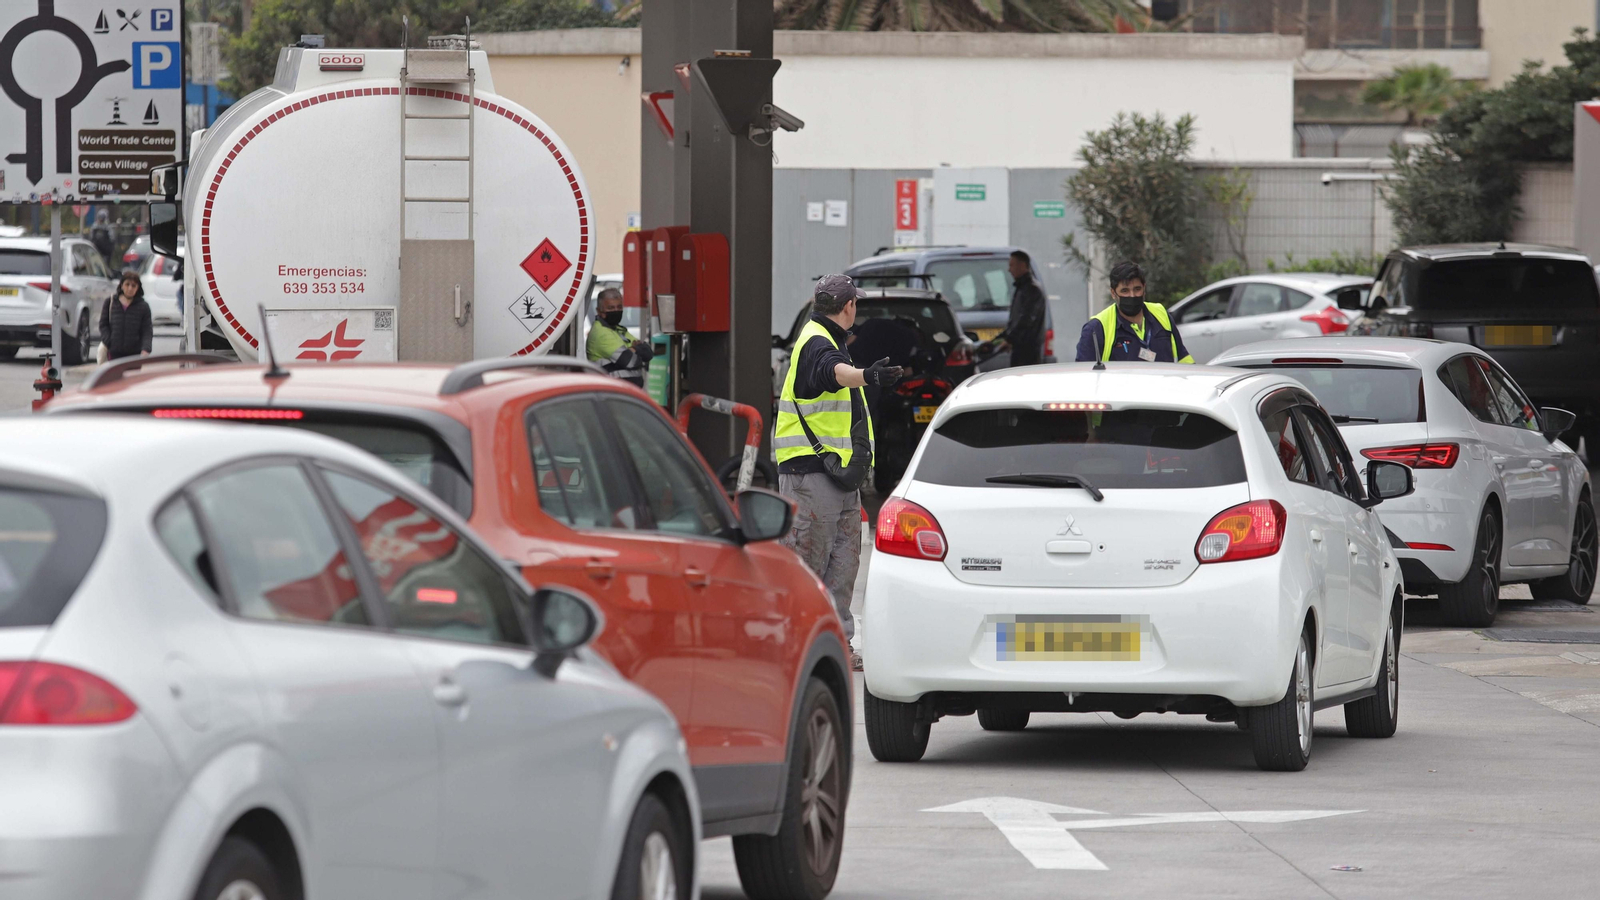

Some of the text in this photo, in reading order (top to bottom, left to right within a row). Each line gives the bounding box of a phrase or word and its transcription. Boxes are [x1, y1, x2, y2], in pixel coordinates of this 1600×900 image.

[155, 10, 170, 30] P
[321, 54, 363, 64] cobo
[140, 44, 172, 87] P
[80, 135, 175, 145] World Trade Center
[80, 159, 149, 171] Ocean Village
[80, 181, 113, 191] Mina
[901, 203, 911, 226] 3
[278, 264, 367, 280] Emergencias:
[543, 274, 549, 283] 3
[283, 282, 365, 294] 639 353 534
